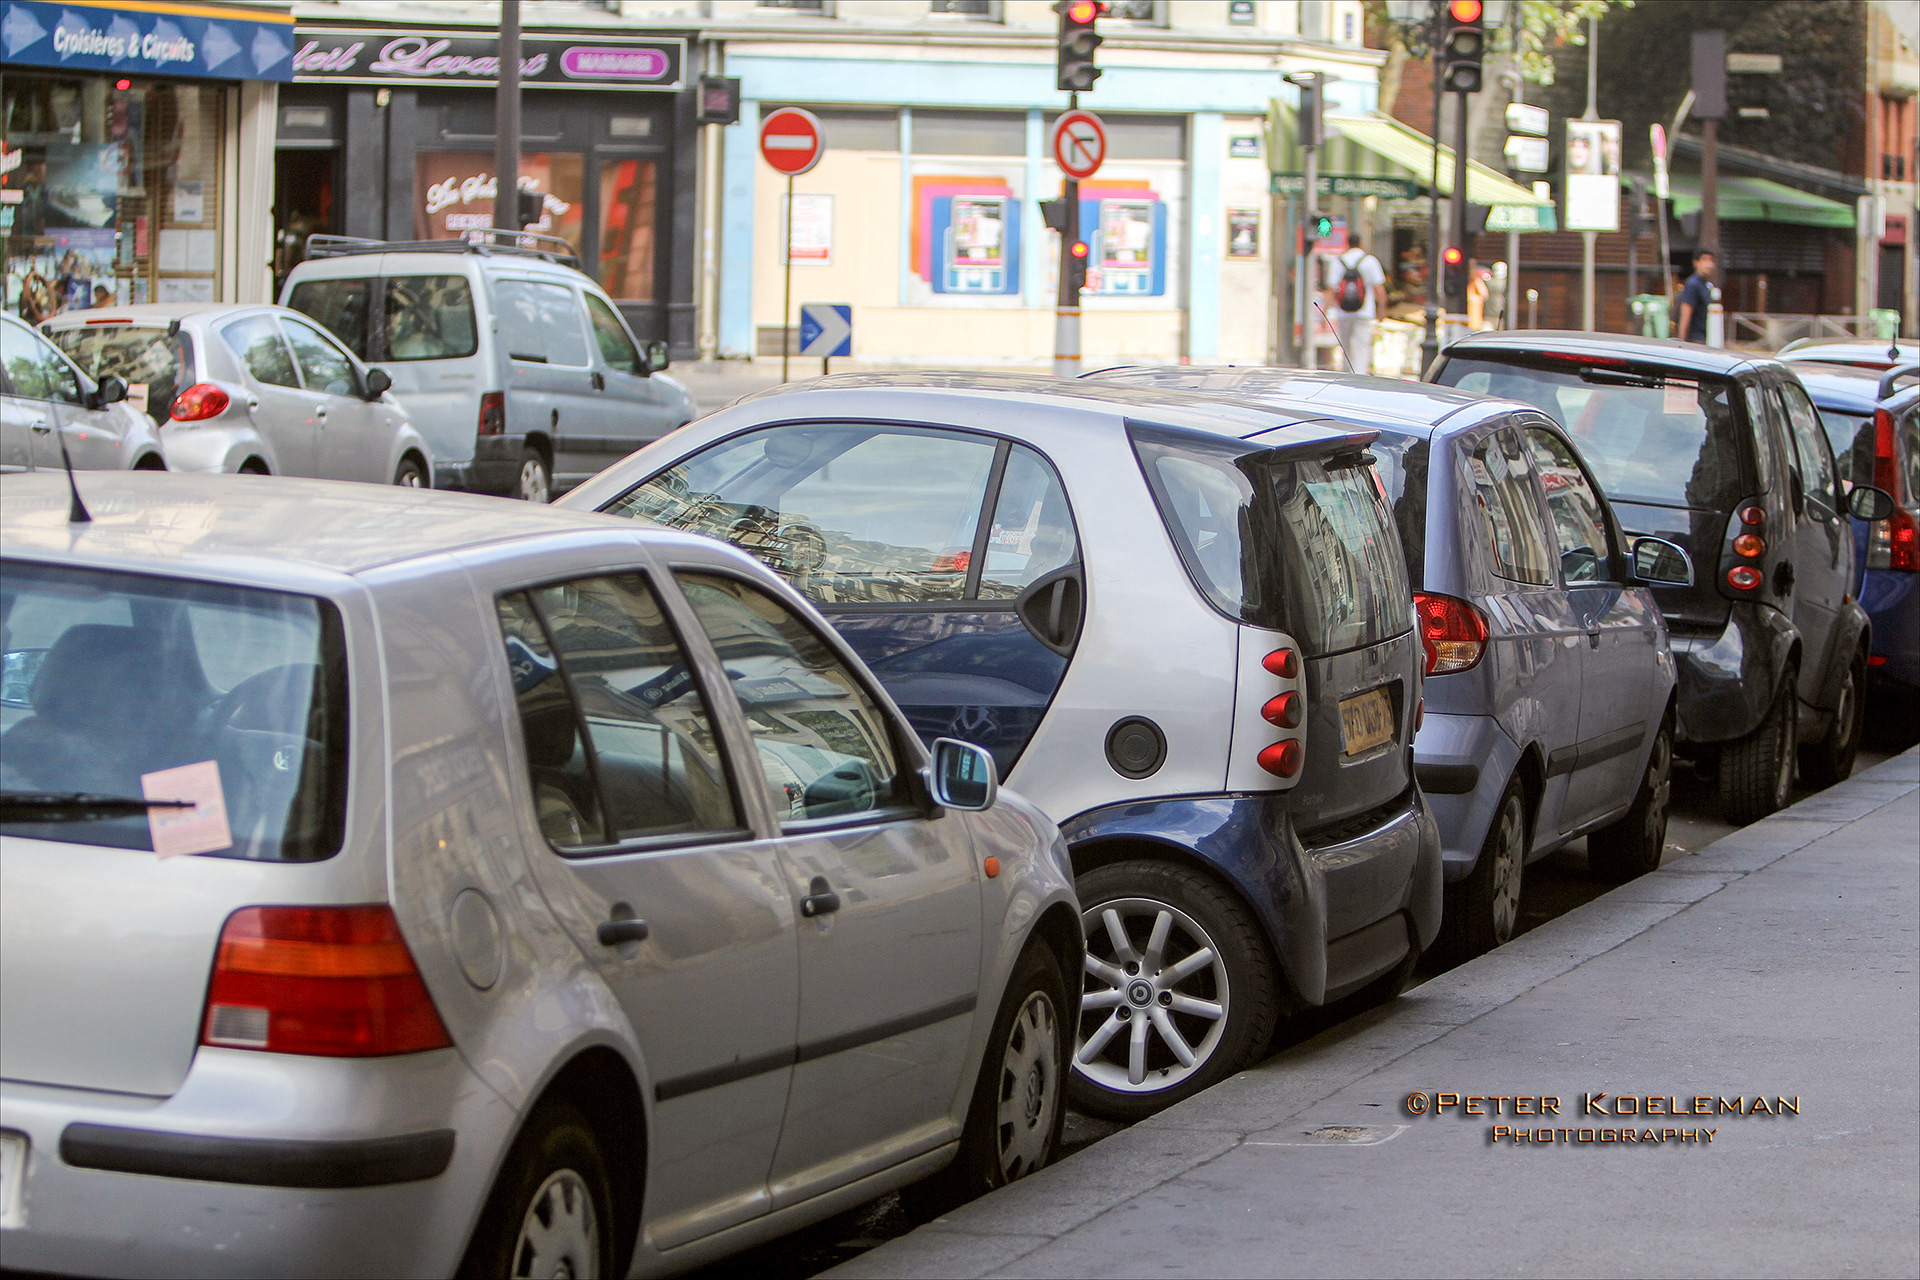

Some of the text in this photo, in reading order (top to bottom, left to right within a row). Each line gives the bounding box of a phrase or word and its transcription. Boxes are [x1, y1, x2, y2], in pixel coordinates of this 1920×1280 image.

[53, 25, 195, 63] Croisières & Circuits
[292, 36, 549, 77] leil Levat
